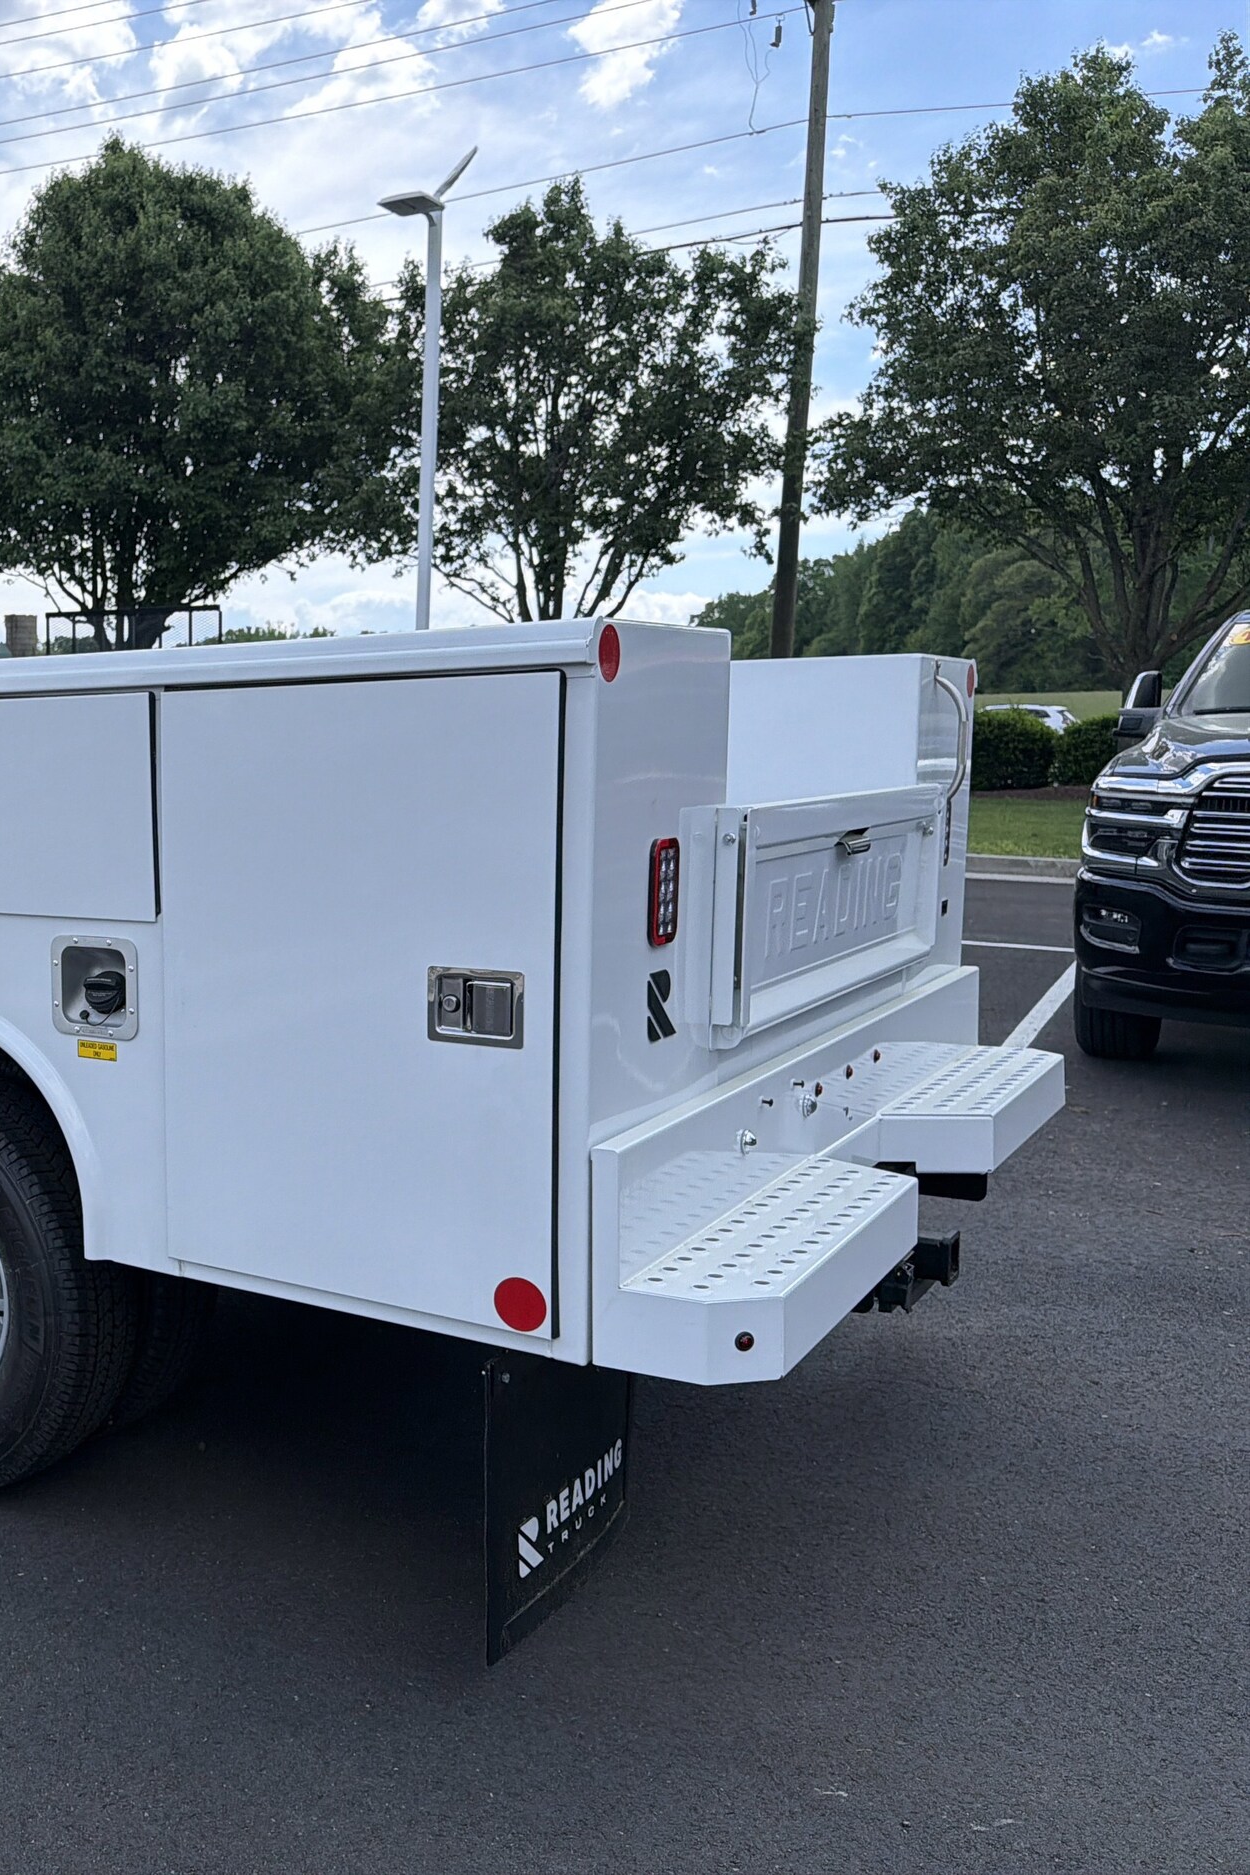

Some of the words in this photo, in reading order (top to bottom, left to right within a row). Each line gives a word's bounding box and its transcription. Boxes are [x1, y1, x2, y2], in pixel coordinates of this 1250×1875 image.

[764, 852, 903, 959] READING
[546, 1438, 623, 1535] READING
[548, 1493, 607, 1554] TRUCK
